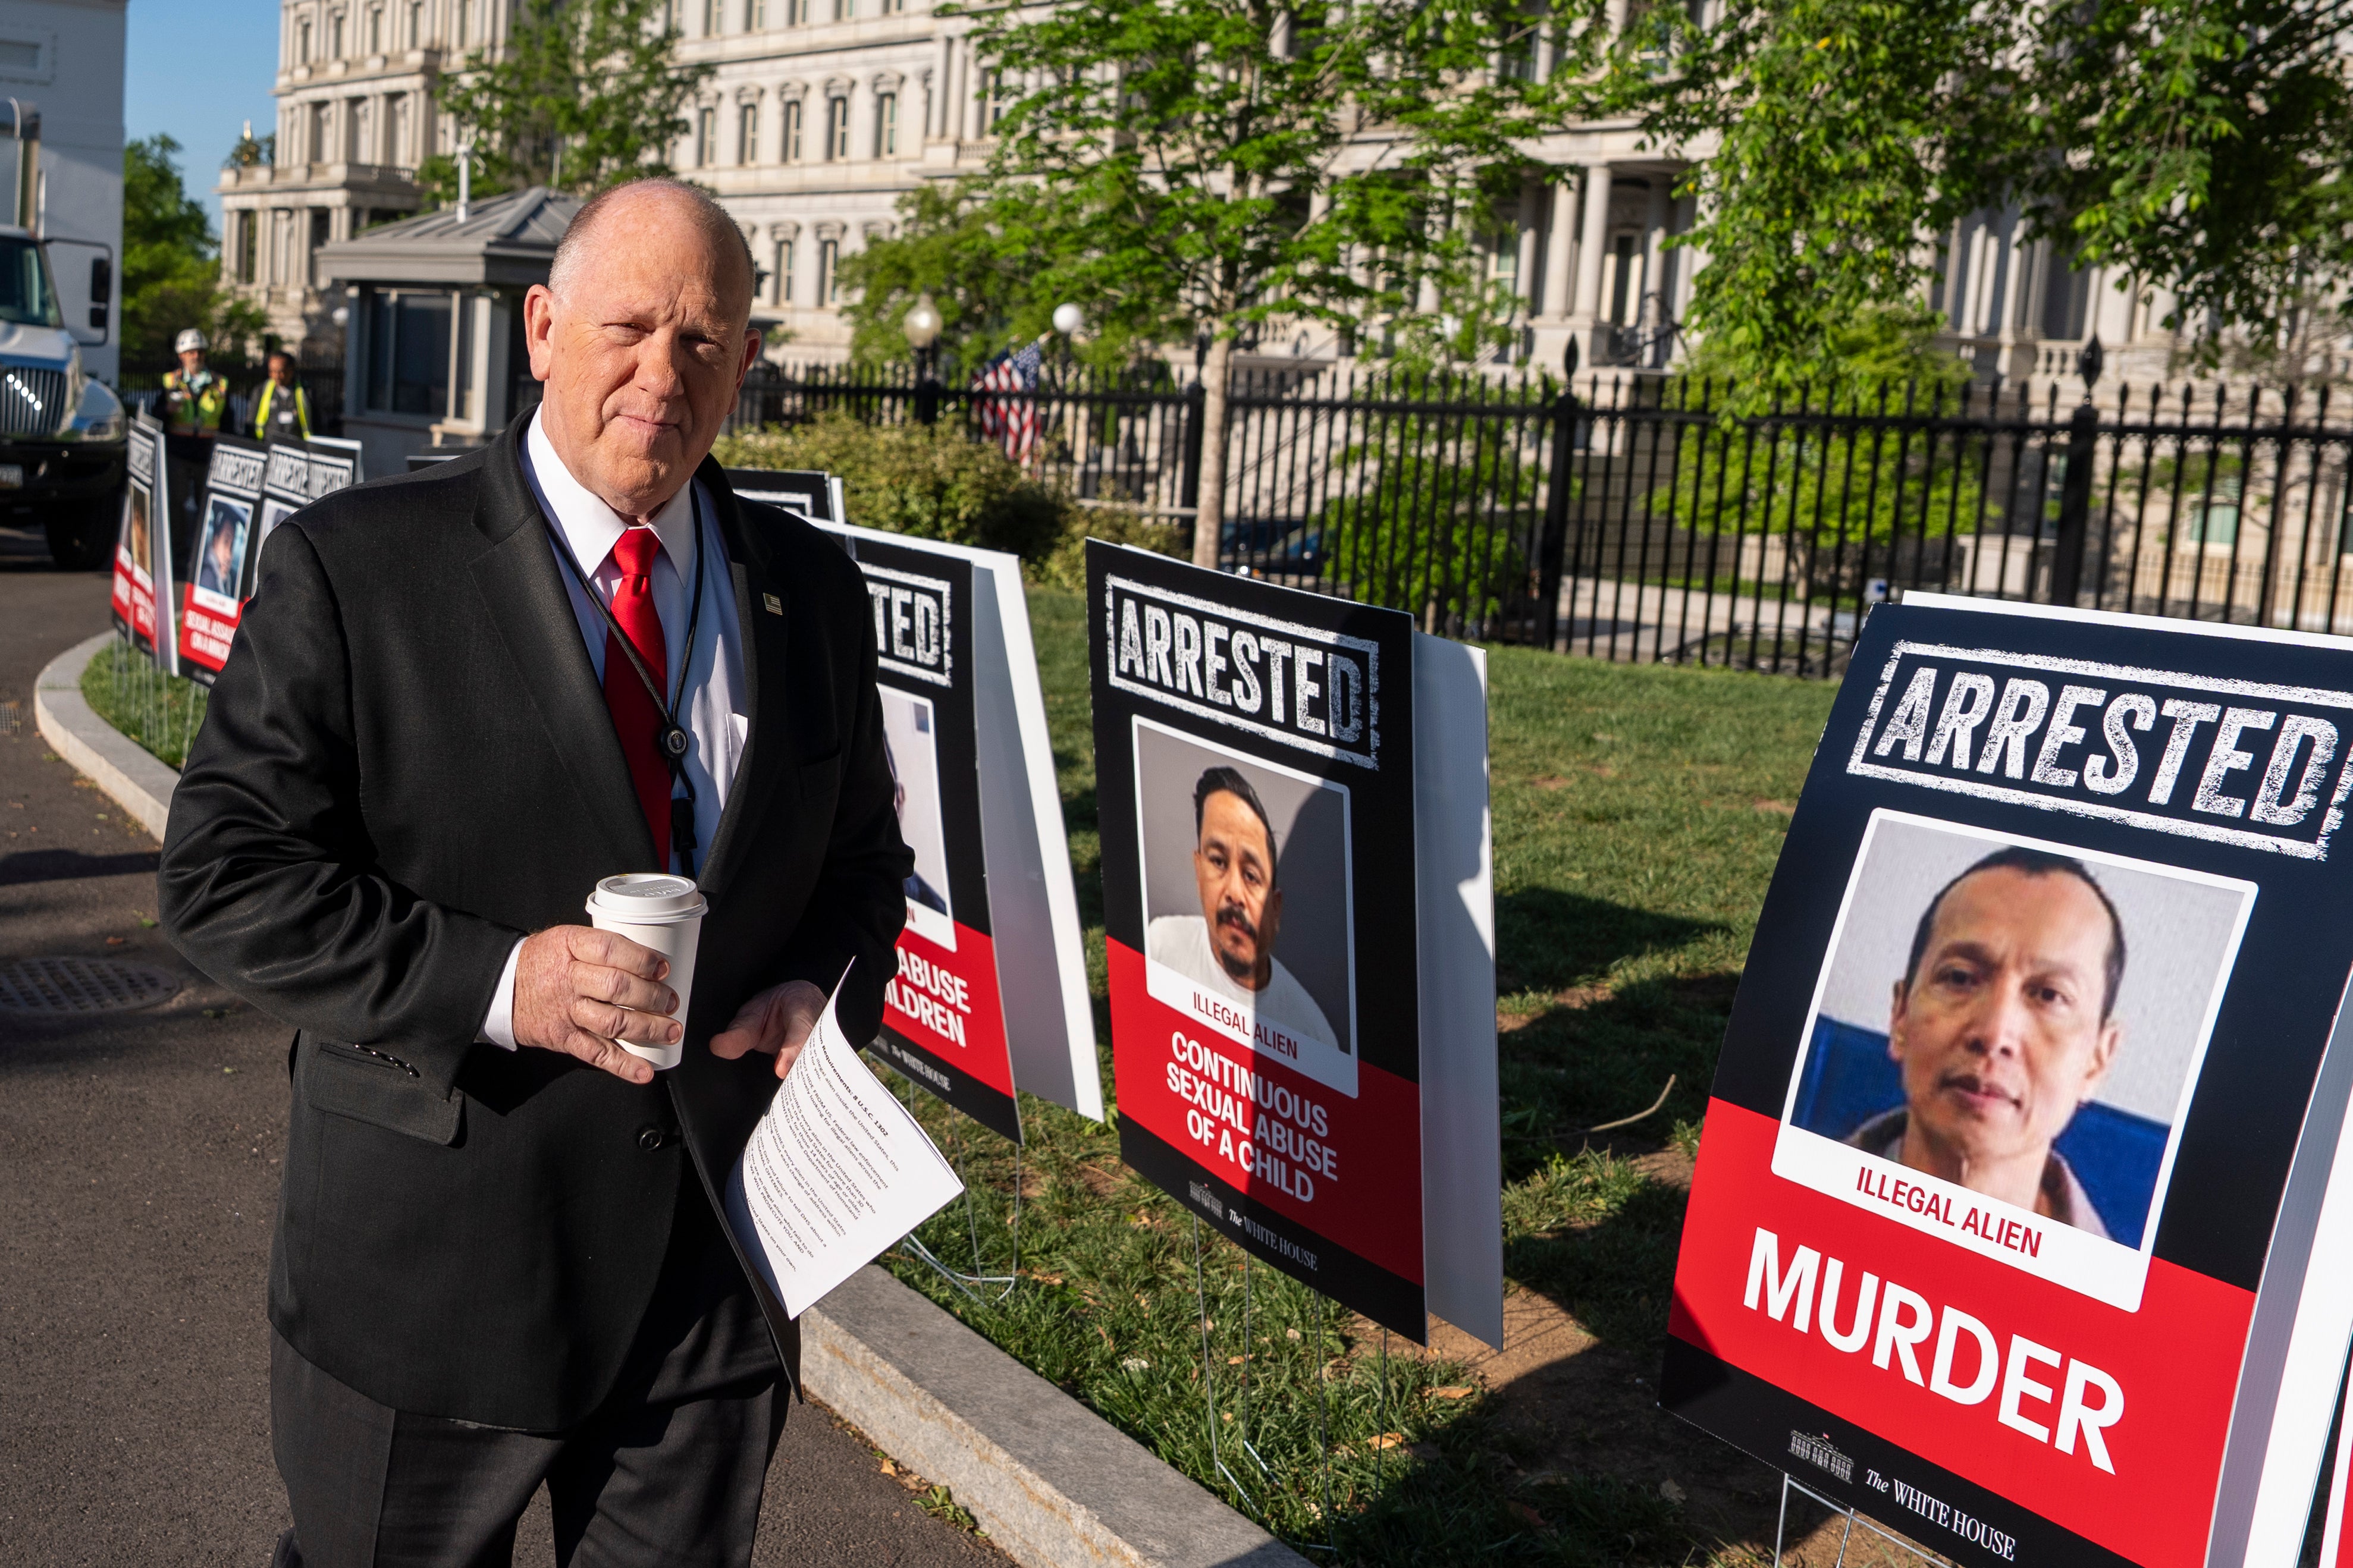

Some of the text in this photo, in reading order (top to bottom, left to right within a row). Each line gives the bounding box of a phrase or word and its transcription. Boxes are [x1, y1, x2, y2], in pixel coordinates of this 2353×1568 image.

[1119, 598, 1363, 743] ARRESTED
[1874, 667, 2339, 827] ARRESTED
[885, 978, 967, 1049] ILDREN
[896, 945, 972, 1014] ABUSE
[1193, 991, 1298, 1060] ILLEGAL ALIEN
[816, 1058, 827, 1077] illegal
[825, 1078, 836, 1092] alien
[835, 1092, 849, 1110] inside
[849, 1110, 858, 1120] the
[858, 1120, 875, 1140] United
[874, 1139, 889, 1160] States,
[889, 1159, 899, 1172] this
[822, 1045, 853, 1095] Requirements:
[858, 1101, 873, 1120] U.S.C.
[874, 1120, 888, 1136] 1302
[1166, 1061, 1338, 1182] SEXUAL ABUSE
[1171, 1031, 1328, 1137] CONTINUOUS
[765, 1168, 783, 1199] OFFENSES.
[772, 1117, 785, 1149] REQUIRES
[784, 1149, 795, 1166] every
[794, 1167, 805, 1181] alien
[810, 1187, 818, 1198] the
[817, 1198, 833, 1217] United
[832, 1217, 846, 1236] States
[789, 1124, 797, 1139] with
[803, 1149, 830, 1184] Department
[834, 1191, 858, 1220] Homeland
[790, 1082, 802, 1114] REQUIRES
[801, 1114, 812, 1131] every
[811, 1132, 823, 1146] alien
[827, 1152, 836, 1162] the
[835, 1162, 852, 1183] United
[851, 1182, 865, 1201] States
[865, 1201, 876, 1214] who
[798, 1132, 810, 1149] those
[815, 1158, 828, 1173] years
[833, 1181, 843, 1190] age
[848, 1198, 861, 1215] older,
[799, 1121, 813, 1142] United
[812, 1142, 826, 1161] States
[826, 1160, 834, 1169] for
[833, 1170, 846, 1185] more
[846, 1186, 857, 1199] than
[857, 1199, 864, 1208] 30
[810, 1095, 824, 1118] looking
[830, 1127, 845, 1144] illegal
[844, 1145, 858, 1161] aliens
[858, 1161, 873, 1180] across
[873, 1179, 881, 1190] the
[813, 1089, 826, 1109] FROM
[833, 1120, 851, 1141] Federal
[850, 1140, 859, 1152] law
[859, 1152, 888, 1189] enforcement
[1187, 1108, 1314, 1202] OF A CHILD
[761, 1192, 783, 1225] PROSECUTE
[783, 1226, 793, 1240] YOU,
[793, 1241, 804, 1253] AND
[763, 1186, 774, 1203] illegal
[773, 1204, 783, 1218] alien
[783, 1218, 793, 1231] who
[793, 1230, 802, 1243] fails
[768, 1165, 777, 1177] and
[775, 1177, 788, 1196] failure
[793, 1203, 801, 1213] tell
[800, 1213, 811, 1226] DHS
[810, 1226, 824, 1243] about
[772, 1135, 782, 1153] about
[780, 1154, 790, 1168] each
[789, 1169, 805, 1189] change
[809, 1197, 827, 1218] address
[827, 1218, 841, 1237] within
[1856, 1166, 2043, 1258] ILLEGAL ALIEN
[747, 1197, 759, 1218] United
[758, 1218, 770, 1236] States
[770, 1236, 776, 1244] on
[776, 1244, 786, 1256] your
[786, 1258, 796, 1272] own,
[1229, 1208, 1317, 1271] The WHITE HOUSE
[1743, 1226, 2125, 1475] MURDER
[1867, 1469, 2016, 1562] The WHITE HOUSE
